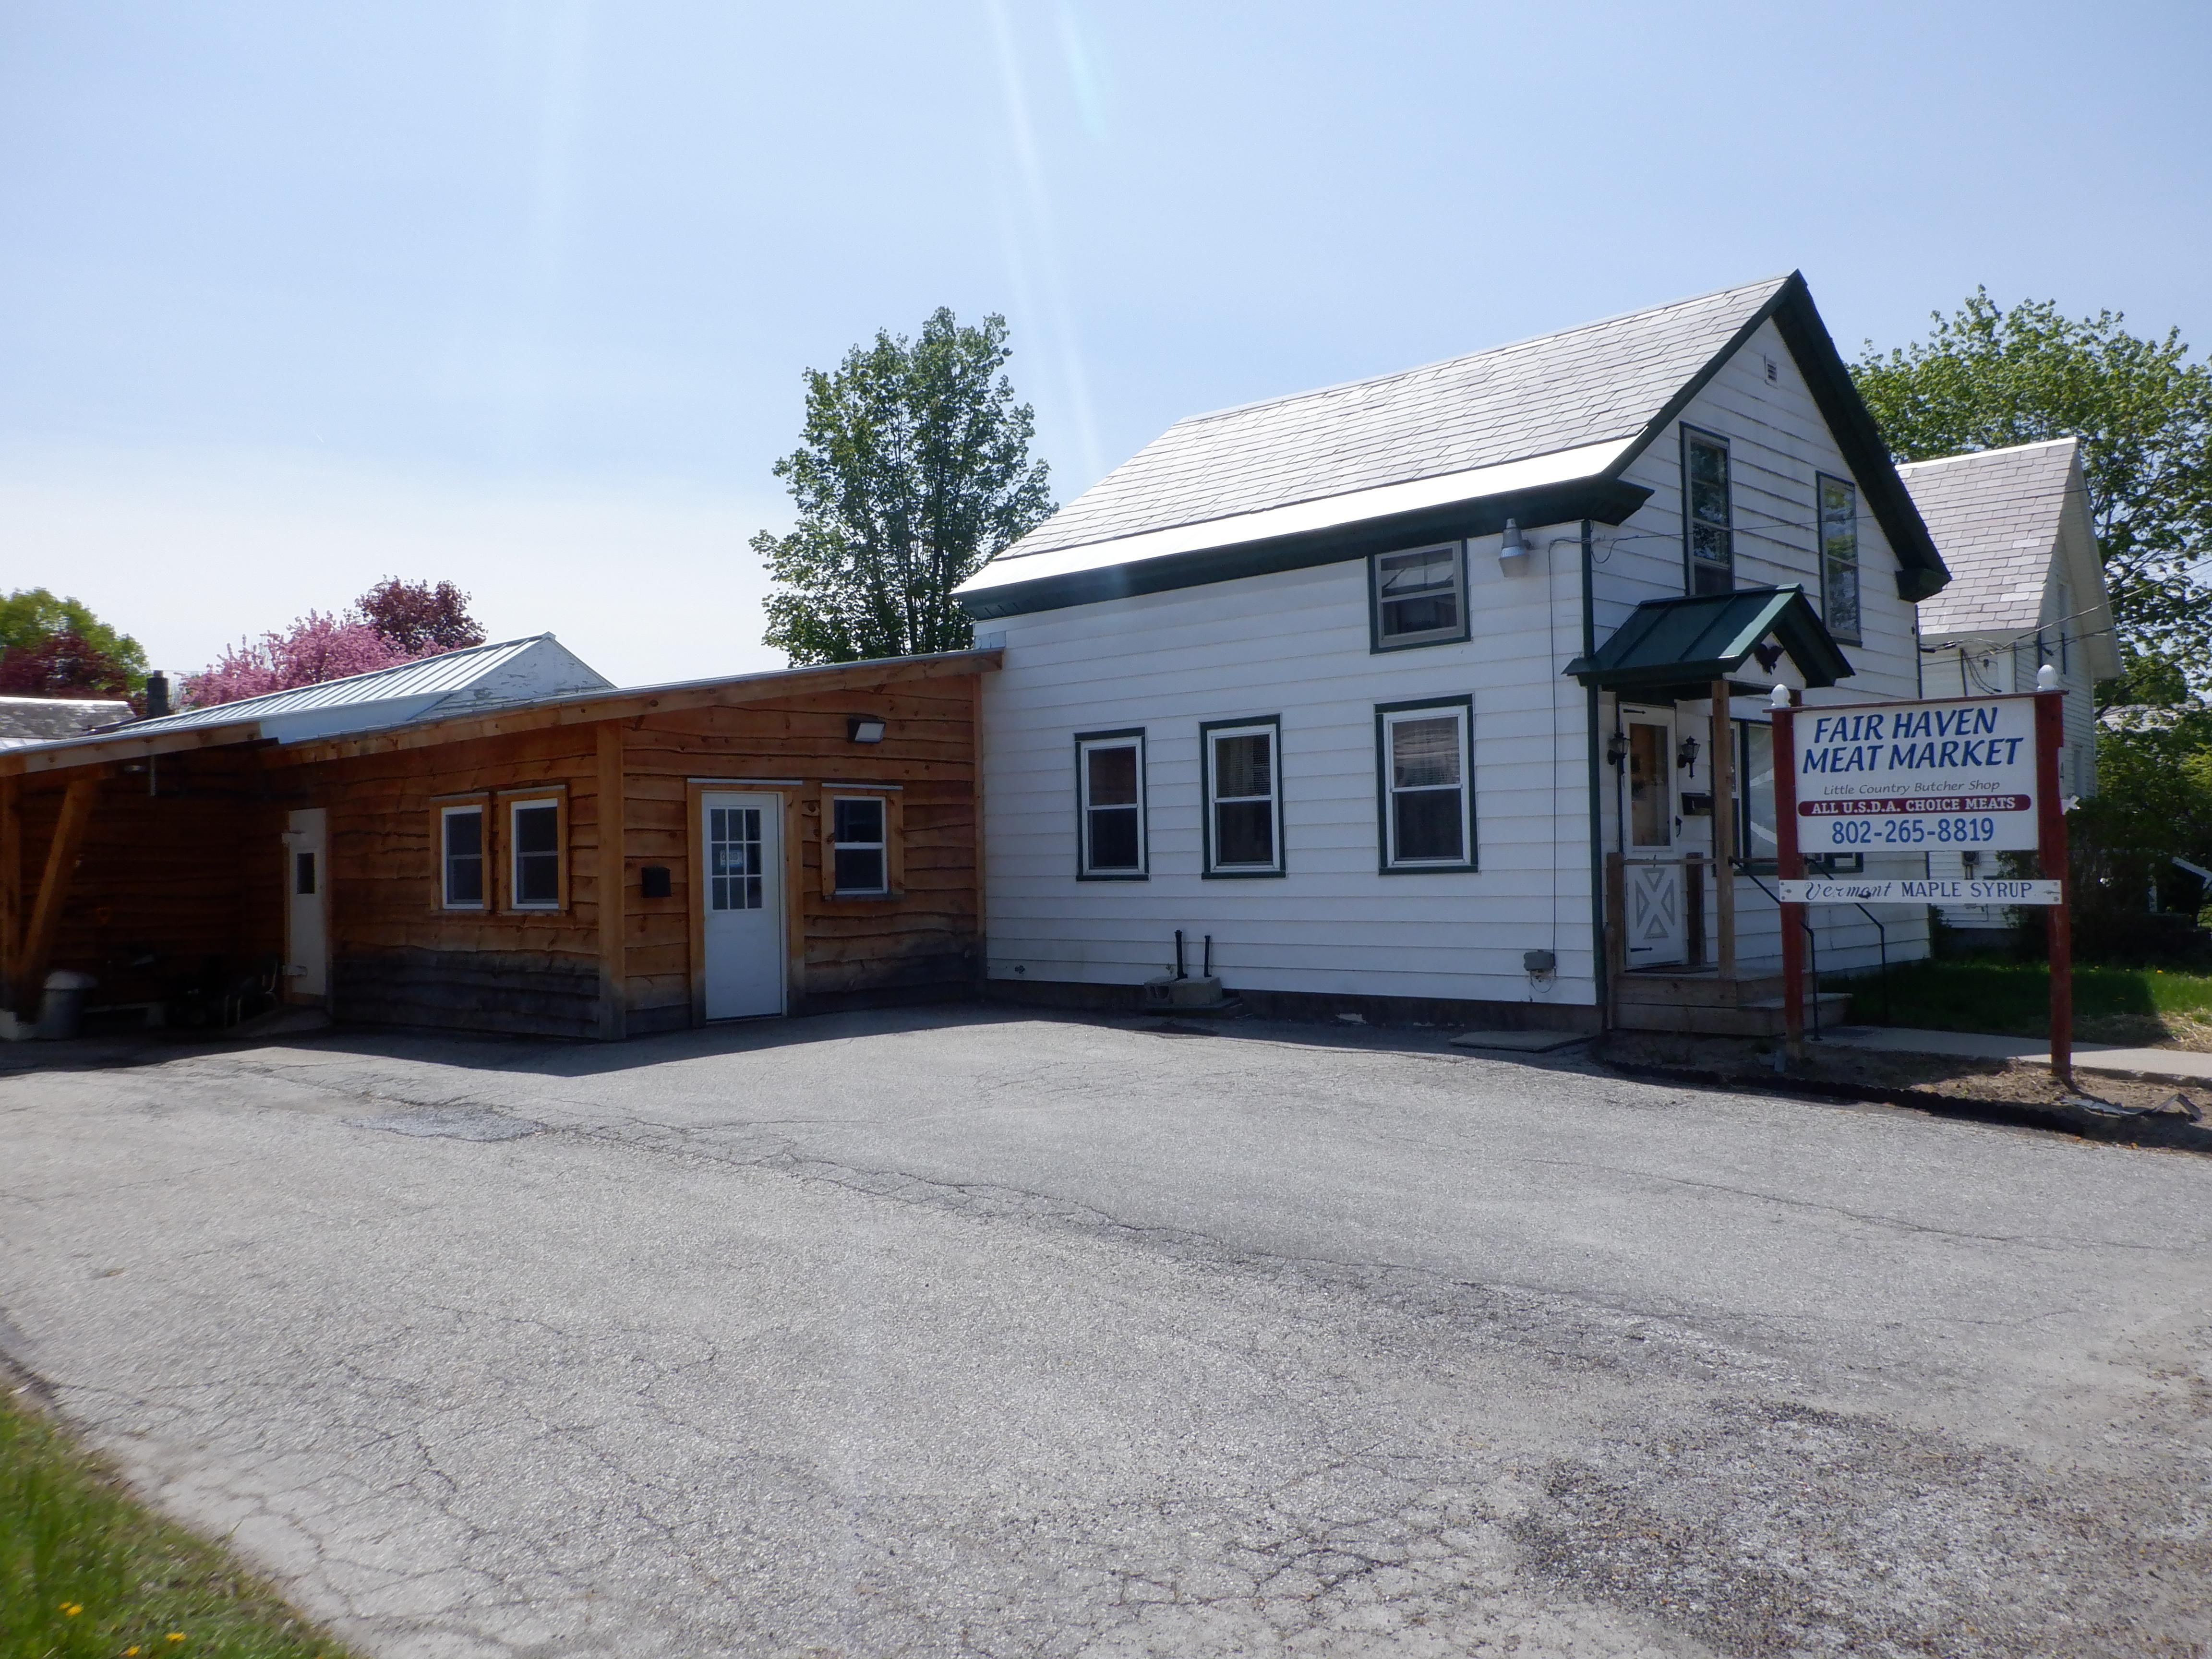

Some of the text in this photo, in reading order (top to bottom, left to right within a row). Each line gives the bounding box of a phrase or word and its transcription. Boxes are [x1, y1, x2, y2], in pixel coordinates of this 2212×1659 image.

[1814, 707, 1998, 744] FAIR HAVEN
[1803, 737, 2024, 774] MEAT MARKET
[1824, 780, 2000, 795] Little Country Butcher Shop
[1811, 797, 2016, 814] ALL U.S.D.A. CHOICE MEATS
[1832, 817, 1994, 844] 802-265-8819
[1805, 882, 2032, 901] Vermont MAPLE SYRUP
